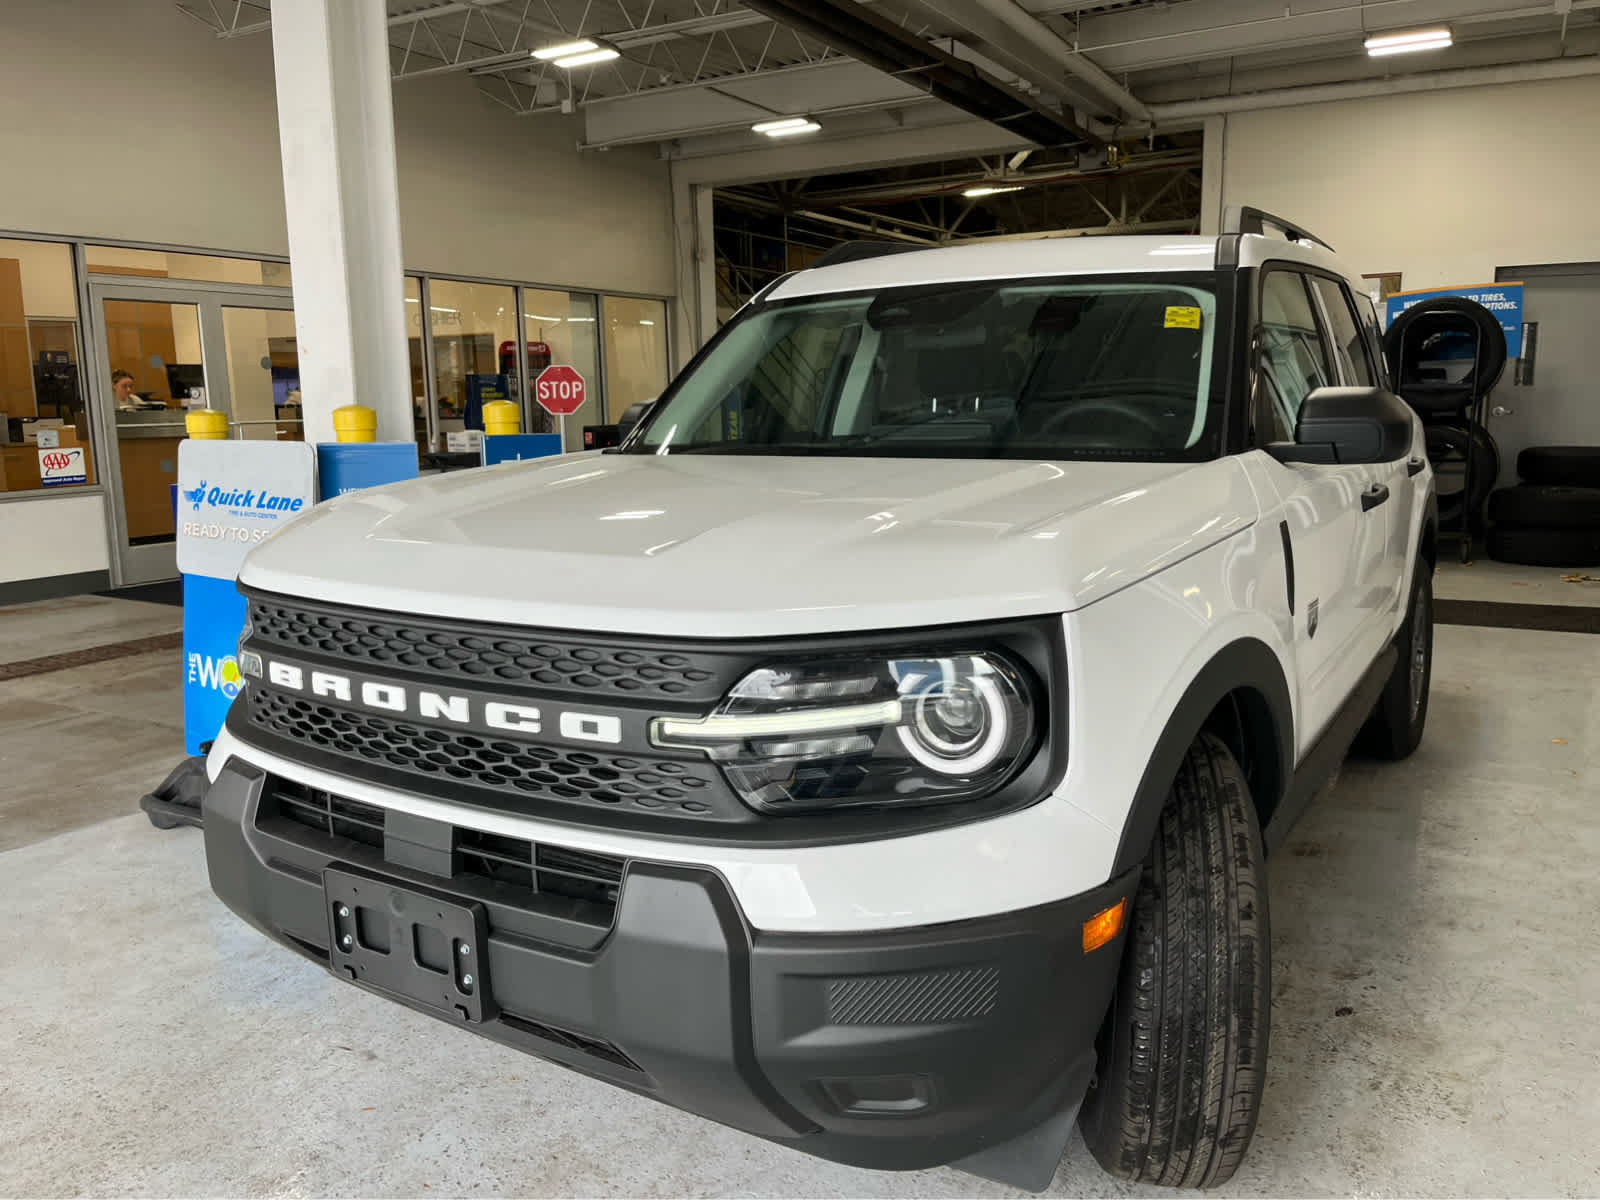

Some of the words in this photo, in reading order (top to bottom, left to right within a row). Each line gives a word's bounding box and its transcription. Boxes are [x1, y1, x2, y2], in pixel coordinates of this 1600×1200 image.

[539, 381, 582, 399] STOP
[43, 453, 70, 470] AAA
[207, 487, 256, 507] Quick
[256, 491, 304, 512] Lane
[184, 522, 228, 540] READY
[230, 527, 250, 542] TO
[188, 652, 196, 684] THE
[269, 661, 622, 743] BRONCO
